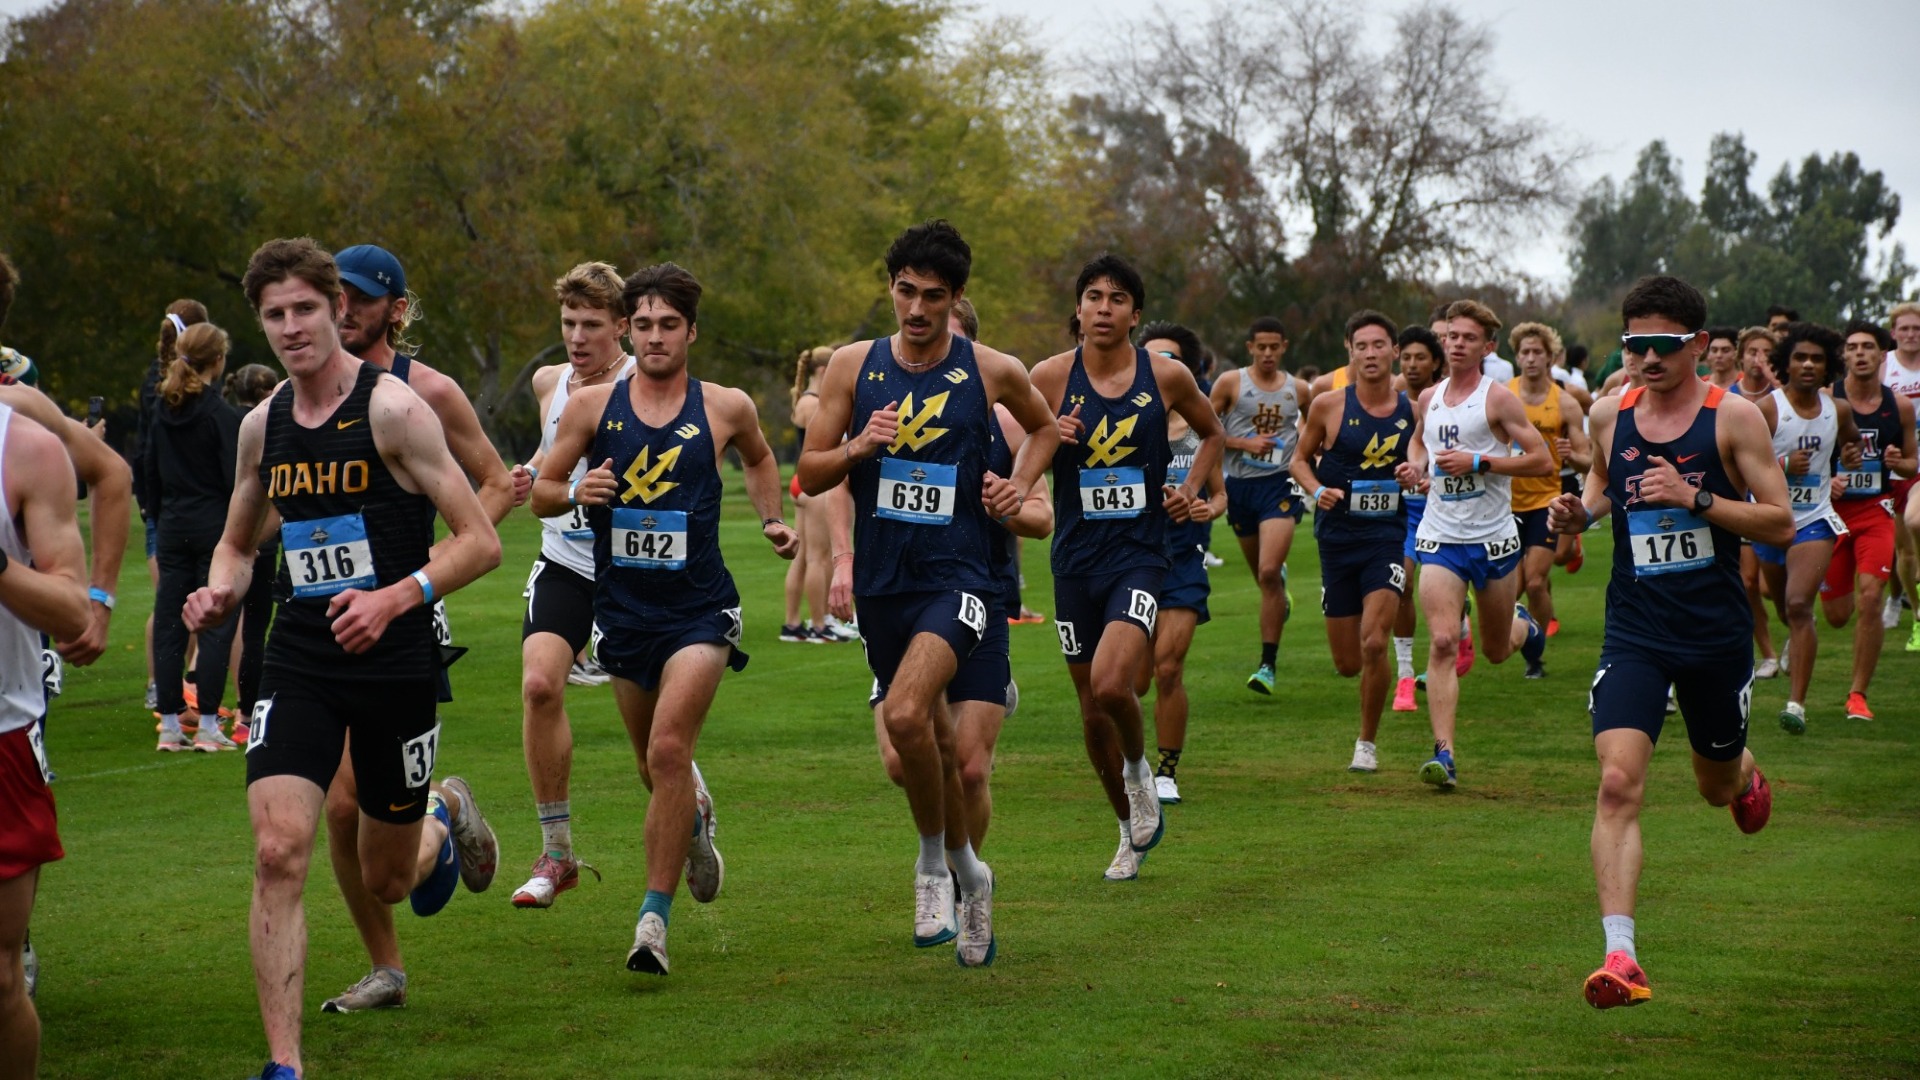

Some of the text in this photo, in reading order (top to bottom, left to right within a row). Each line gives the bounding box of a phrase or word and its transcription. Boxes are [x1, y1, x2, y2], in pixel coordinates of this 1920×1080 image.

[268, 459, 369, 499] IDAHO
[1444, 475, 1476, 494] 623
[1847, 473, 1873, 488] 109
[892, 482, 941, 513] 639
[1092, 486, 1135, 510] 643
[1359, 494, 1390, 511] 638
[625, 531, 673, 559] 642
[1646, 532, 1699, 563] 176
[299, 546, 355, 584] 316
